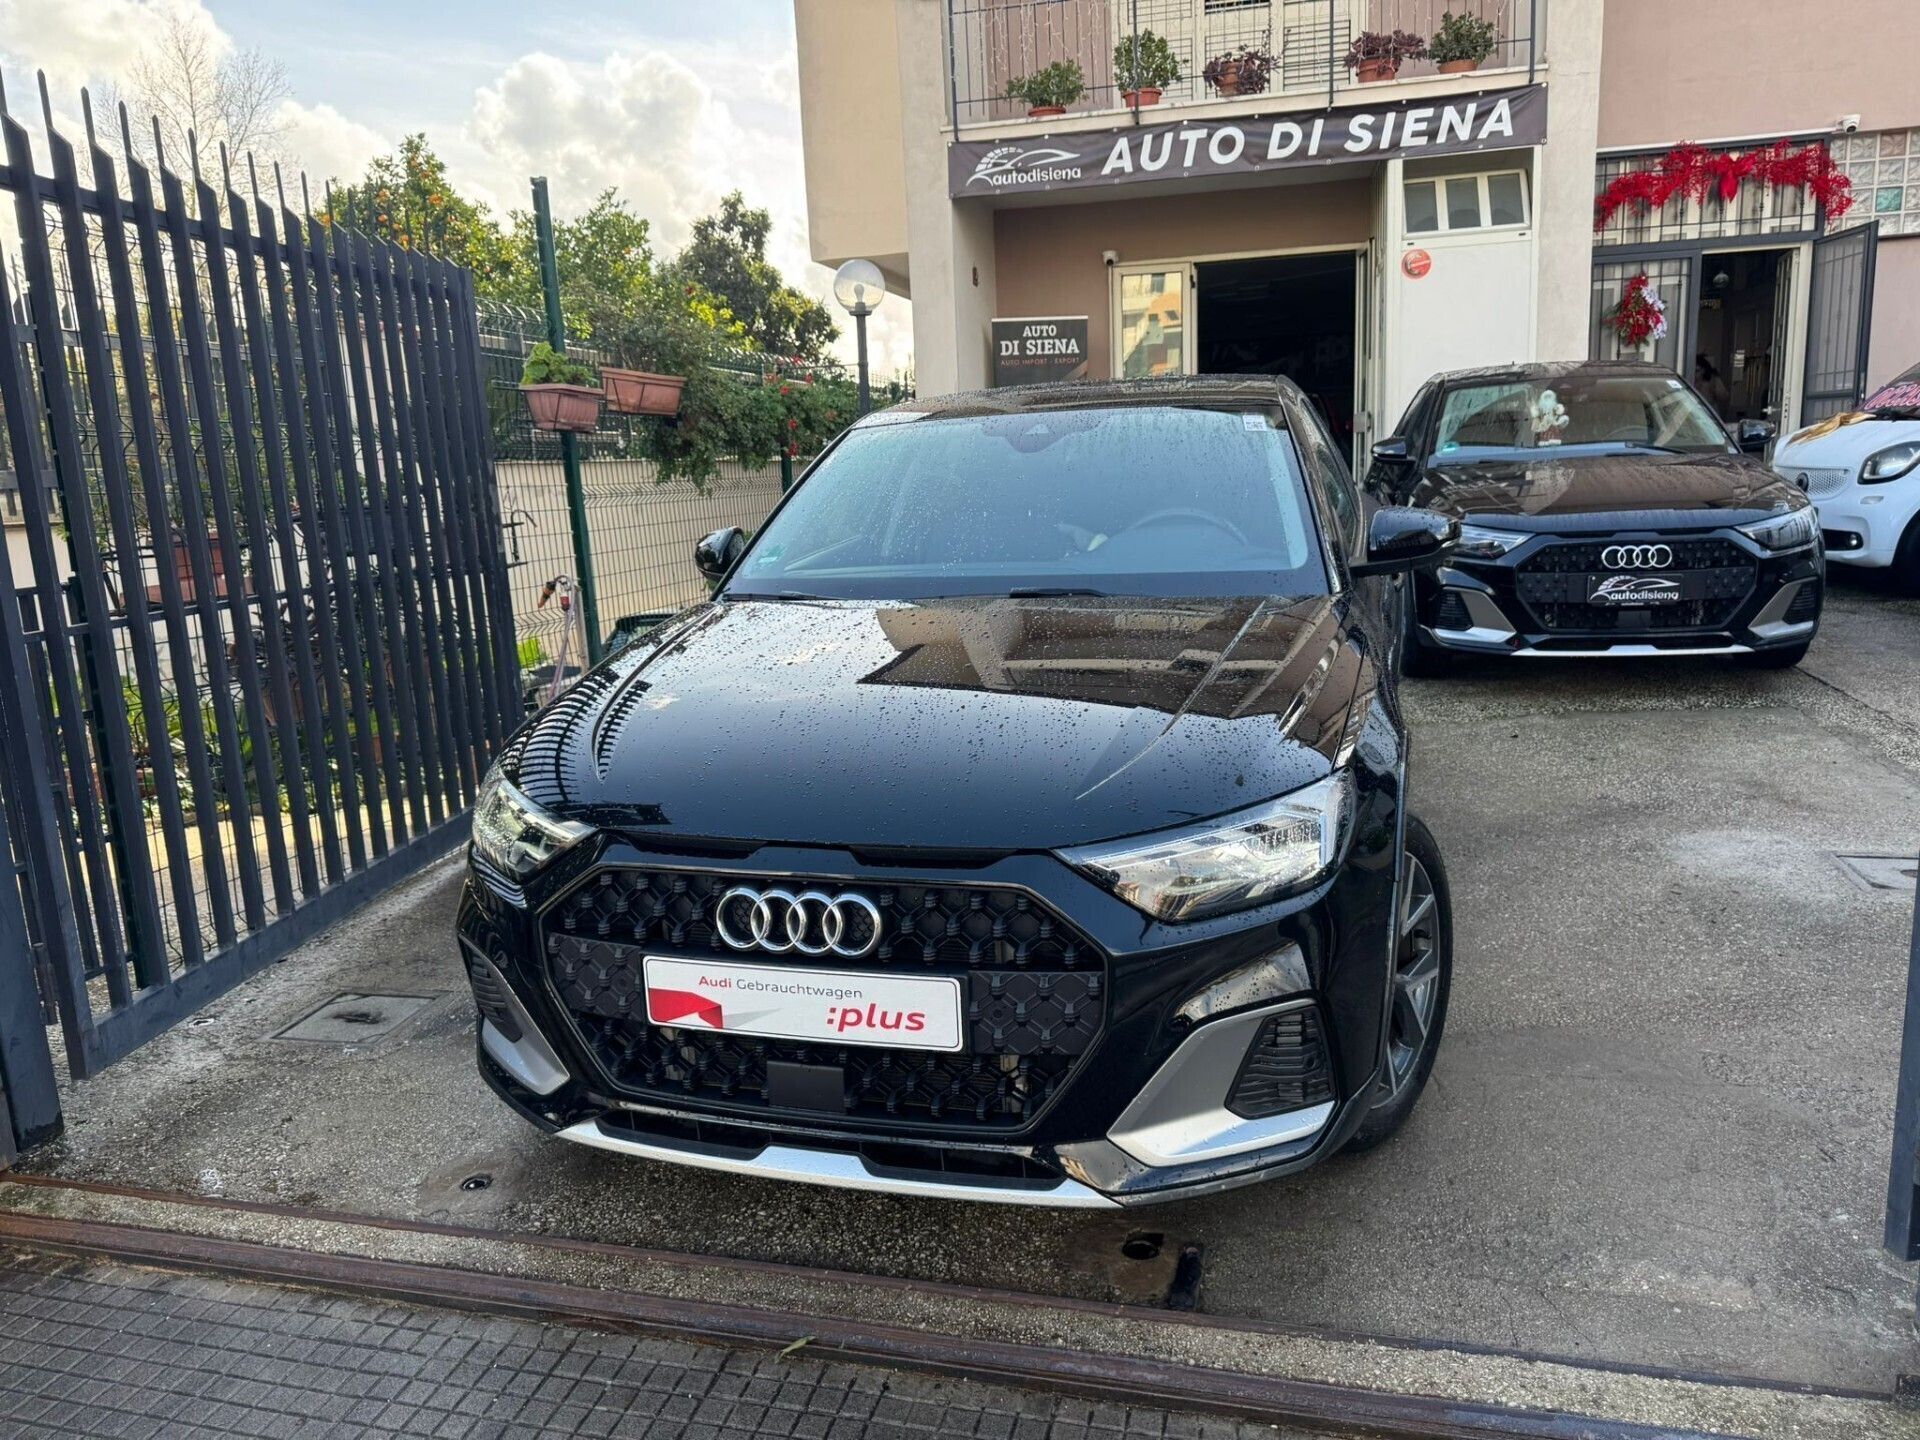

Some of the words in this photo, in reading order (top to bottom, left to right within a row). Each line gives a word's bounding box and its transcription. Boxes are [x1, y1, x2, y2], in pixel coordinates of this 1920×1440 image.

[1101, 126, 1245, 176] AUTO
[1267, 118, 1325, 160] DI
[1343, 98, 1514, 153] SIENA
[1023, 325, 1057, 337] AUTO
[1000, 340, 1020, 356] DI
[1026, 338, 1080, 355] SIENA
[1022, 358, 1047, 366] IMPORT
[1055, 357, 1079, 365] EXPORT
[698, 975, 732, 988] Audi
[736, 978, 863, 999] Gebrauchtwagen
[826, 1003, 926, 1033] :plus
